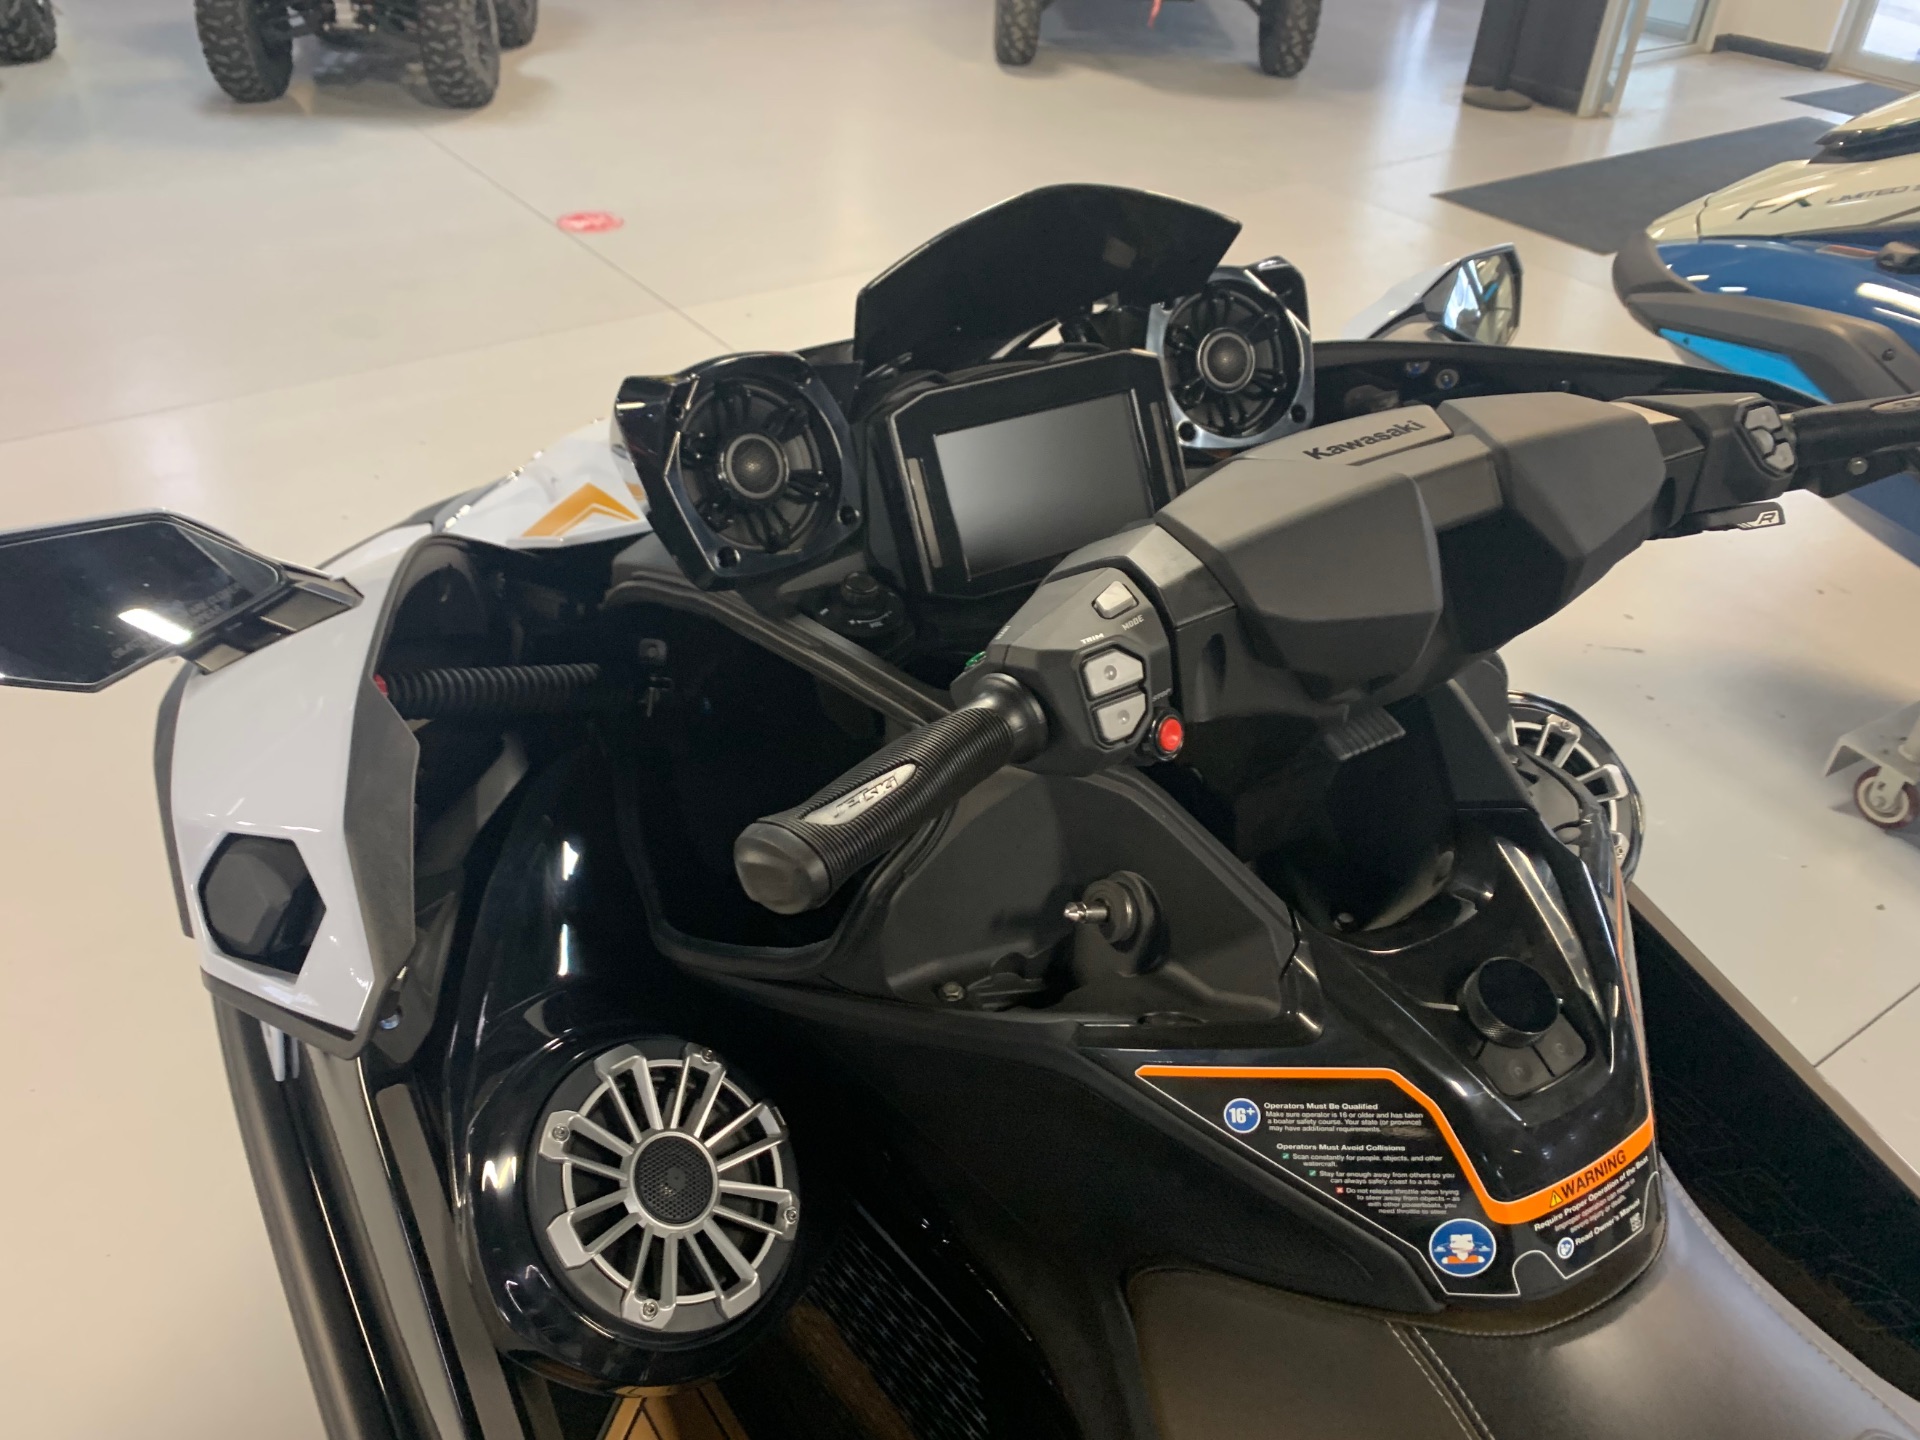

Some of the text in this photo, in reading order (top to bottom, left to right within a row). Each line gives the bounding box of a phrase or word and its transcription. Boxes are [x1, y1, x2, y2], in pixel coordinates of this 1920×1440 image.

[1825, 185, 1910, 204] LIMITED
[1302, 419, 1426, 460] Kawasaki
[1121, 614, 1145, 631] MODE
[1080, 632, 1105, 645] TRIM
[1263, 1102, 1305, 1111] Operators
[1341, 1103, 1379, 1111] Qualified
[1390, 1119, 1422, 1127] province)
[1336, 1126, 1382, 1134] requirements.
[1276, 1143, 1317, 1151] Operators
[1310, 1154, 1345, 1162] constantly
[1319, 1170, 1335, 1178] Stay
[1346, 1171, 1372, 1179] enough
[1560, 1149, 1627, 1198] WARNING
[1368, 1178, 1388, 1186] safely
[1423, 1179, 1441, 1187] stop.
[1395, 1188, 1420, 1196] throttle
[1439, 1189, 1460, 1197] trying
[1534, 1155, 1650, 1232] Require Proper Operation of the Boat
[1575, 1230, 1594, 1246] Read
[1593, 1214, 1620, 1236] Owner's
[1619, 1197, 1641, 1218] Manual
